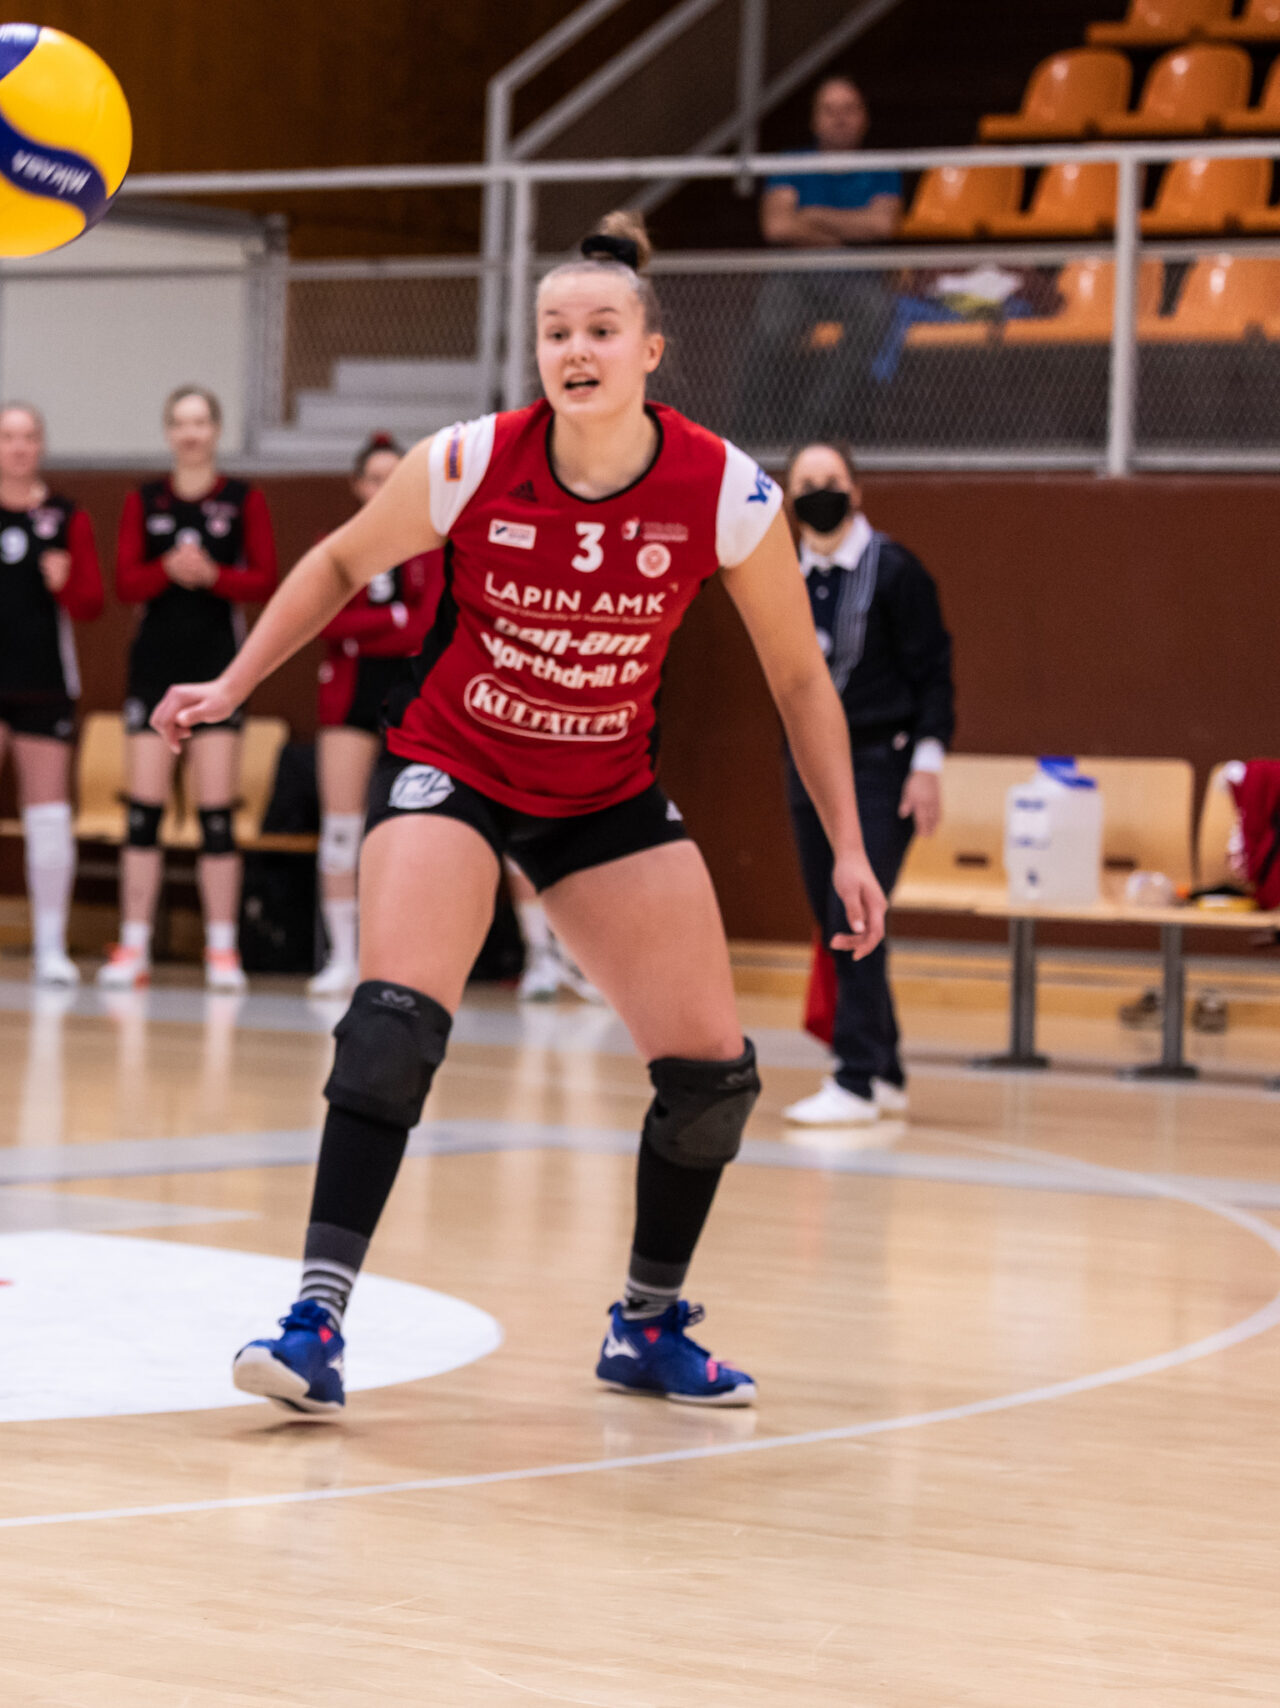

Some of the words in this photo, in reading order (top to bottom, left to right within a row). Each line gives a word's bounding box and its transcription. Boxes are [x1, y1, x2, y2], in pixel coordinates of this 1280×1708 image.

[571, 521, 606, 573] 3
[484, 571, 582, 612] LAPIN
[591, 591, 667, 615] AMK
